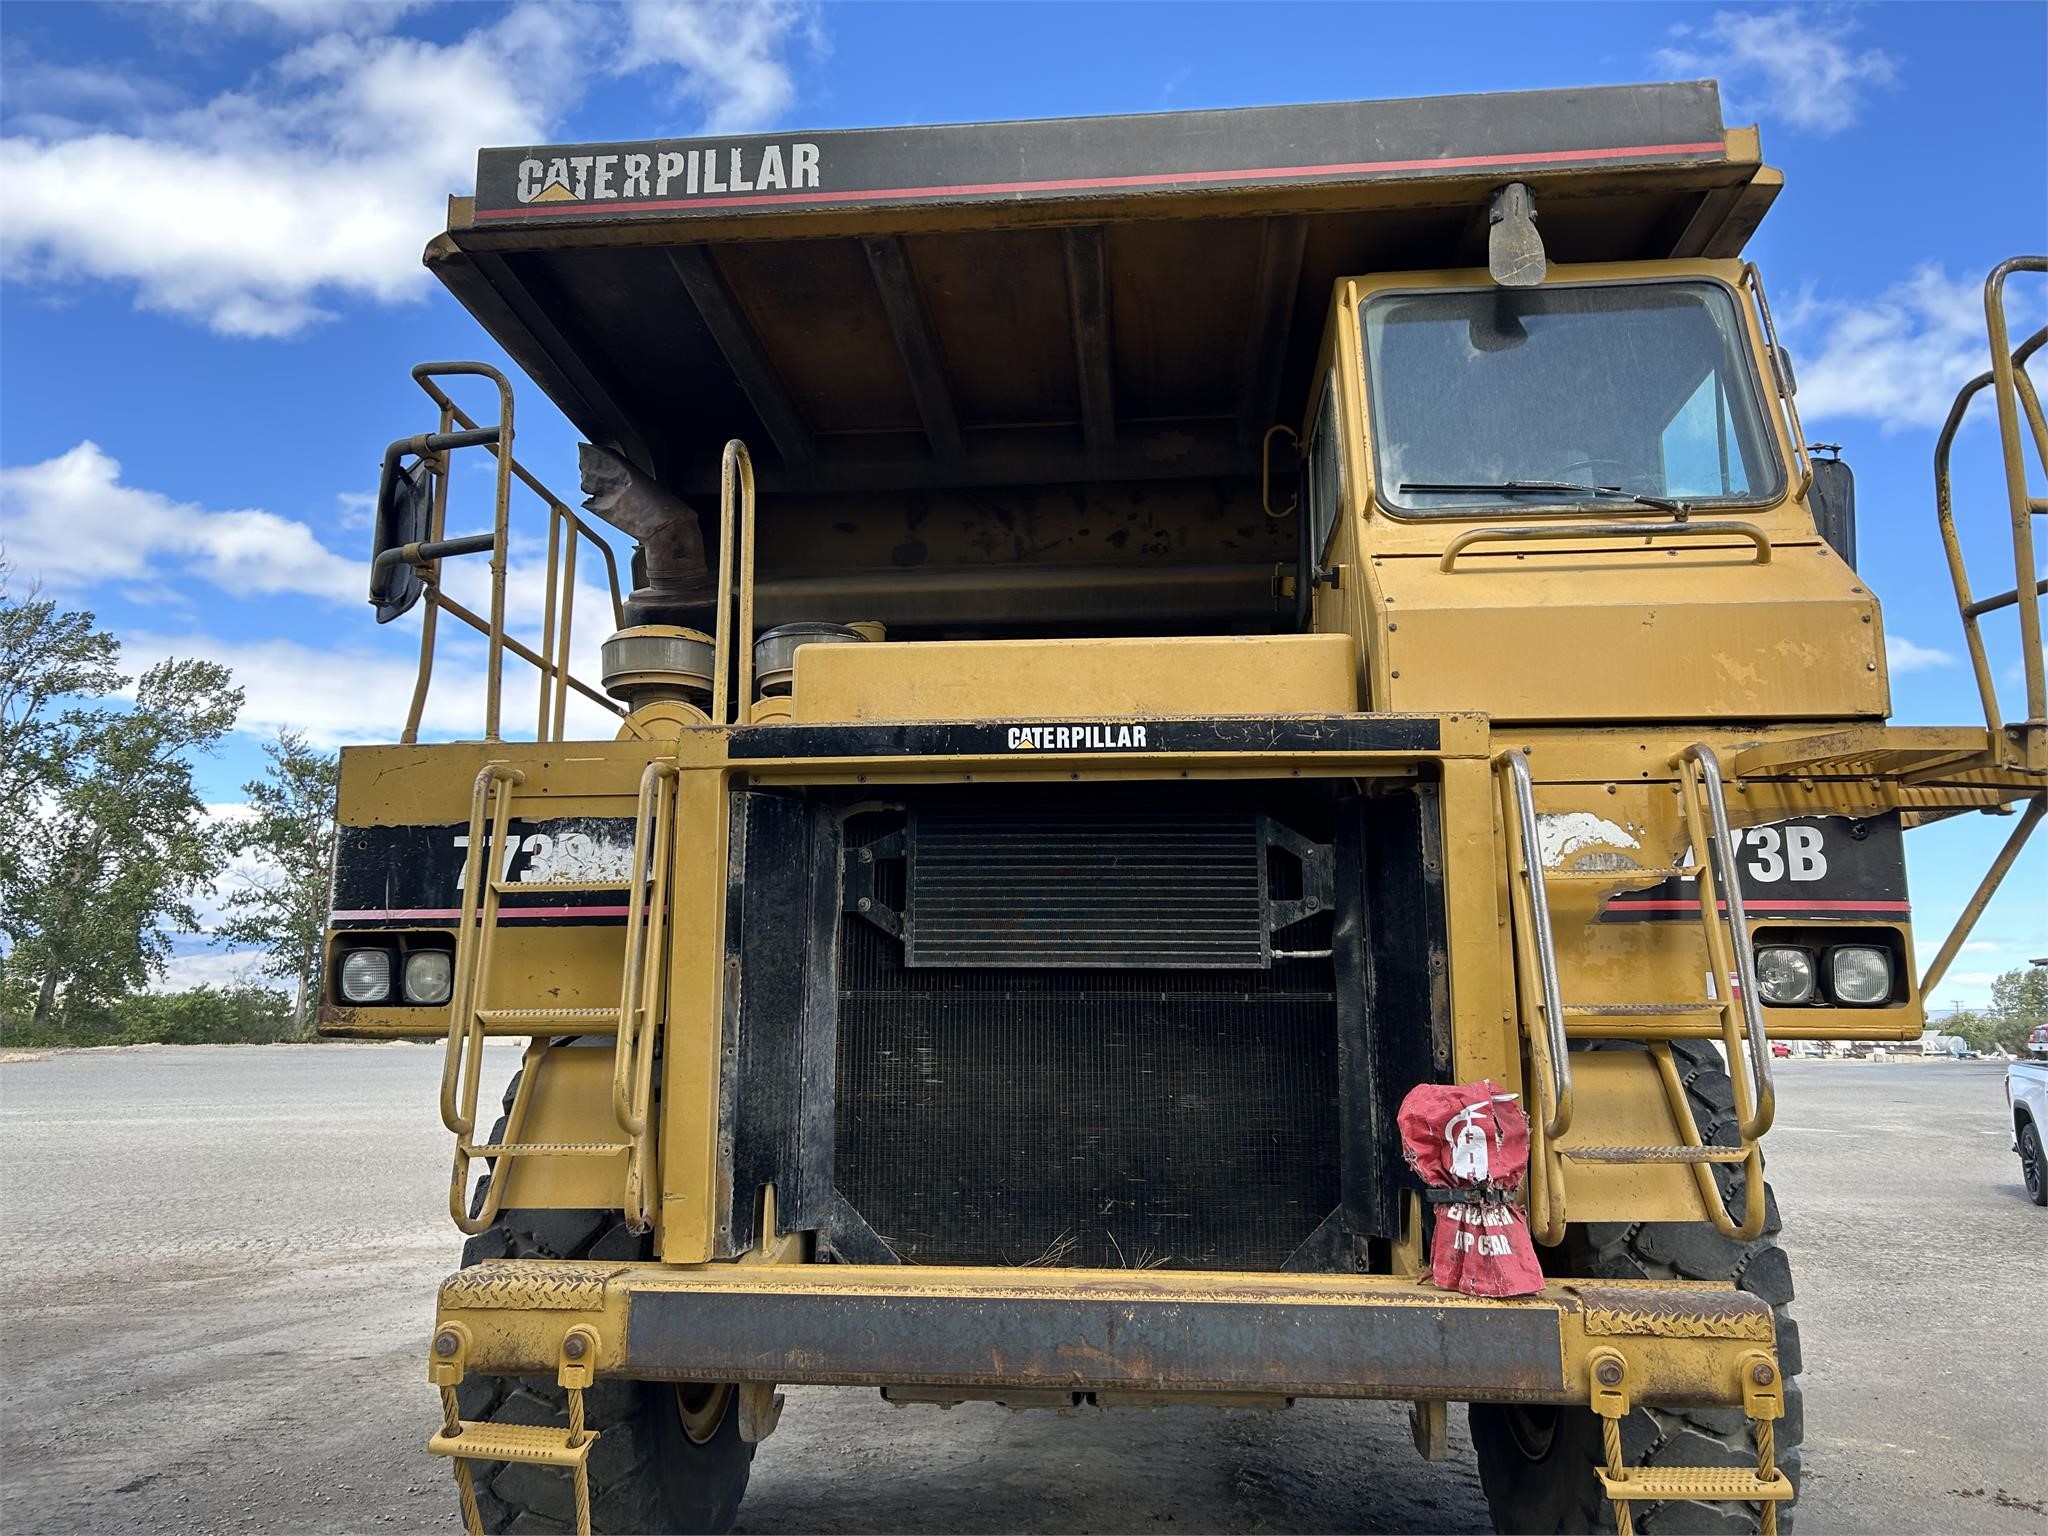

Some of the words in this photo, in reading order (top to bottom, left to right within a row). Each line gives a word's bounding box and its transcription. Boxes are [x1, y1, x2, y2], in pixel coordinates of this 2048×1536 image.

[517, 143, 820, 204] CATERPILLAR
[1008, 725, 1147, 750] CATERPILLAR
[1681, 825, 1828, 883] 3B
